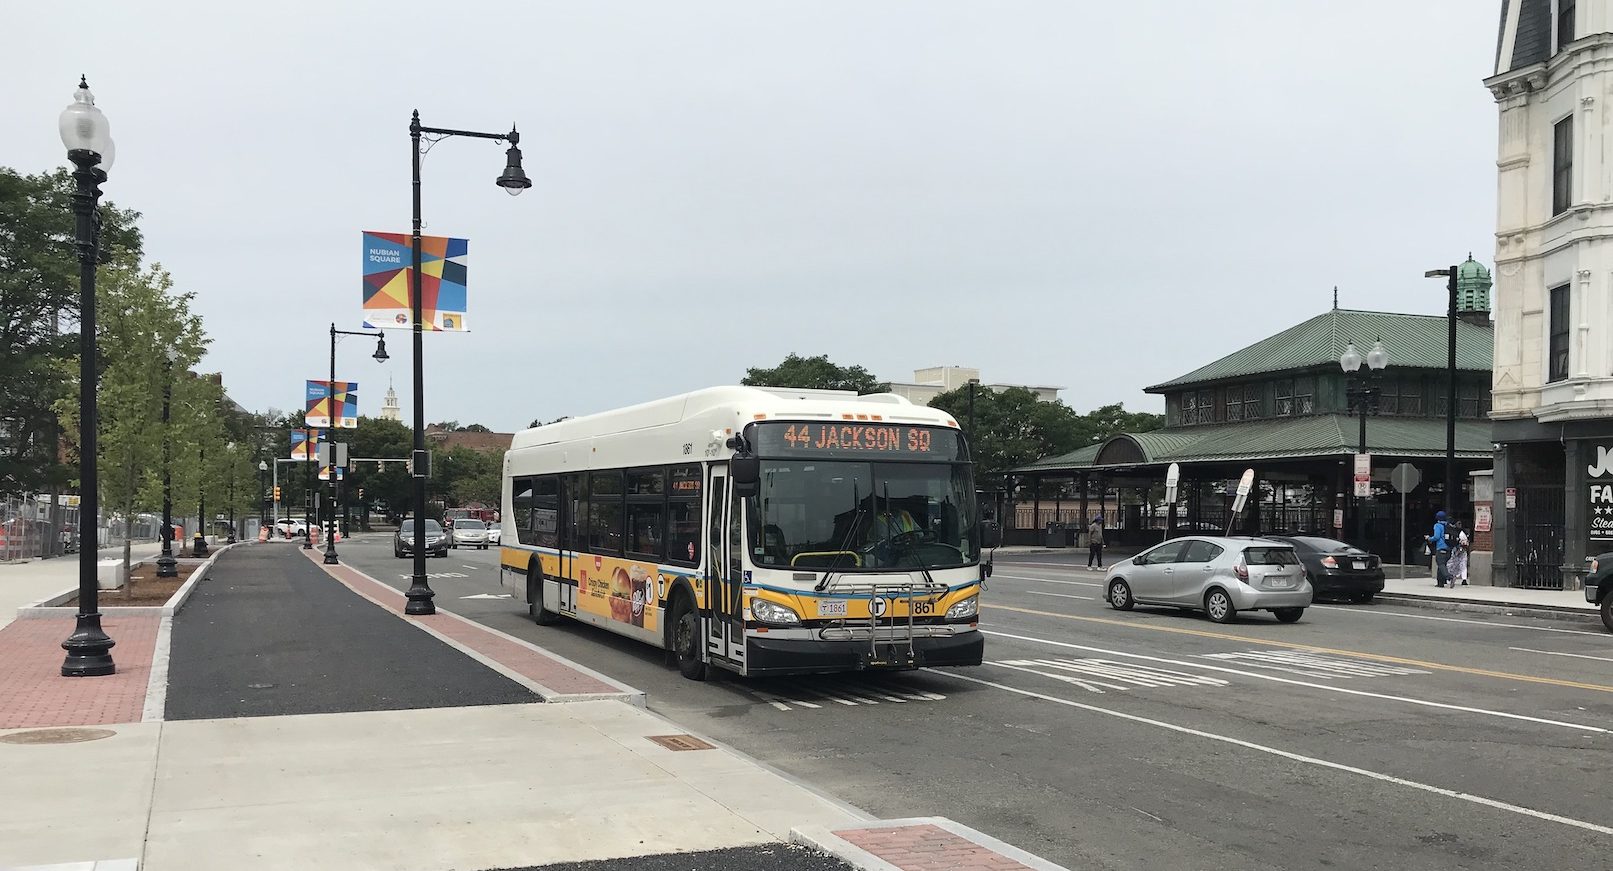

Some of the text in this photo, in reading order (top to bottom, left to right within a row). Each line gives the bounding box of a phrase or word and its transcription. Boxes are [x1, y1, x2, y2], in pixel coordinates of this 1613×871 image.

[369, 248, 400, 257] NUBIAN
[369, 255, 401, 263] SQUARE
[784, 424, 931, 452] 44 JACKSON SQ
[829, 603, 846, 613] 1861
[872, 602, 883, 614] T
